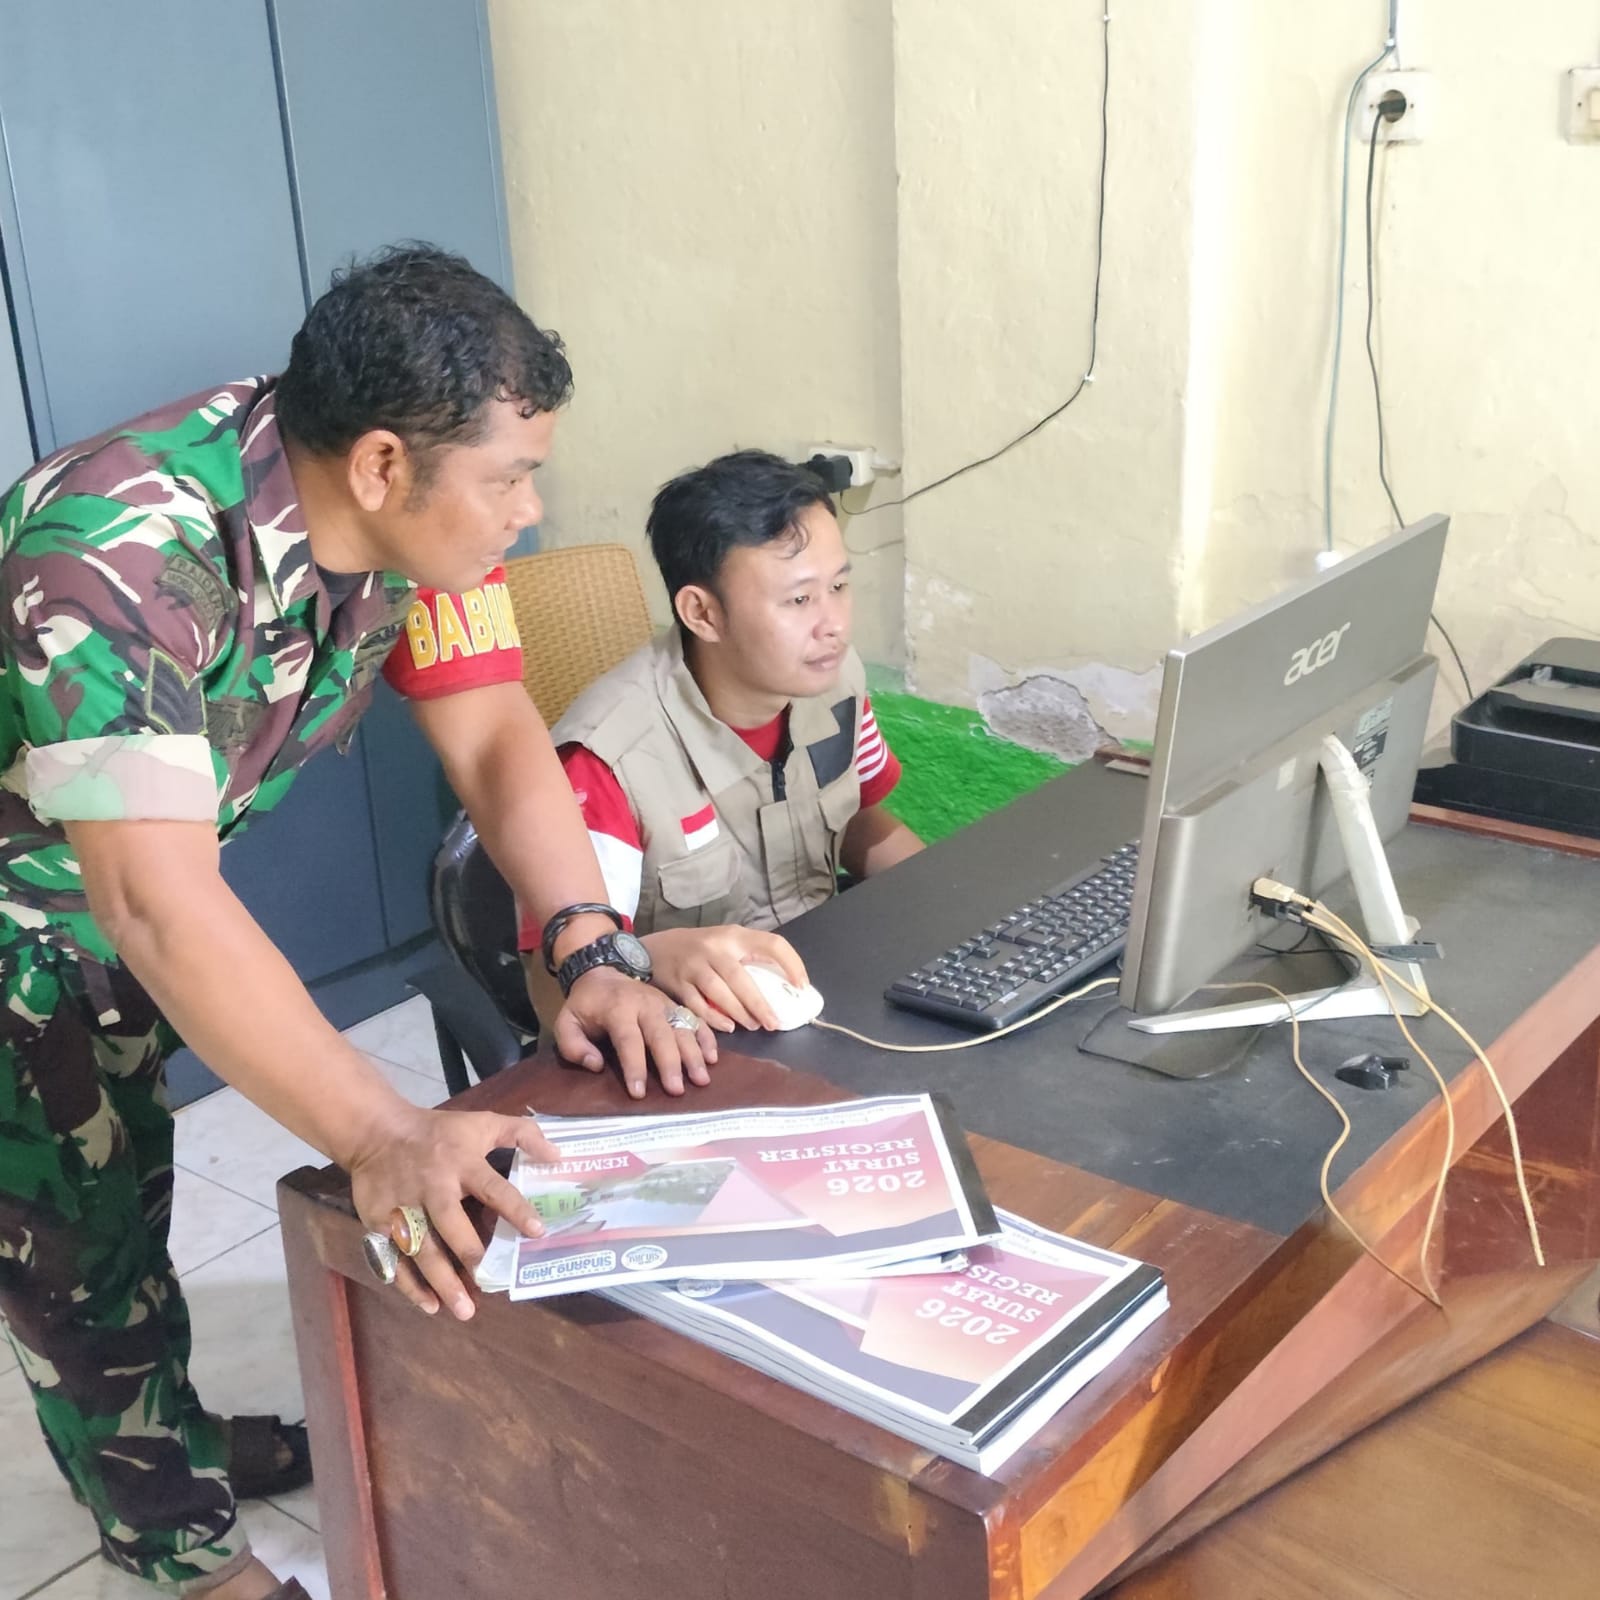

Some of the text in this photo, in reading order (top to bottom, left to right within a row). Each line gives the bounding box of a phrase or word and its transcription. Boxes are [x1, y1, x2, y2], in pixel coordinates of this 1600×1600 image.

[1284, 621, 1351, 686] acer
[757, 1137, 916, 1162] REGISTER
[822, 1152, 921, 1174] SURAT
[826, 1169, 927, 1196] 2026
[941, 1280, 1043, 1322] SURAT
[914, 1298, 1021, 1344] 2026
